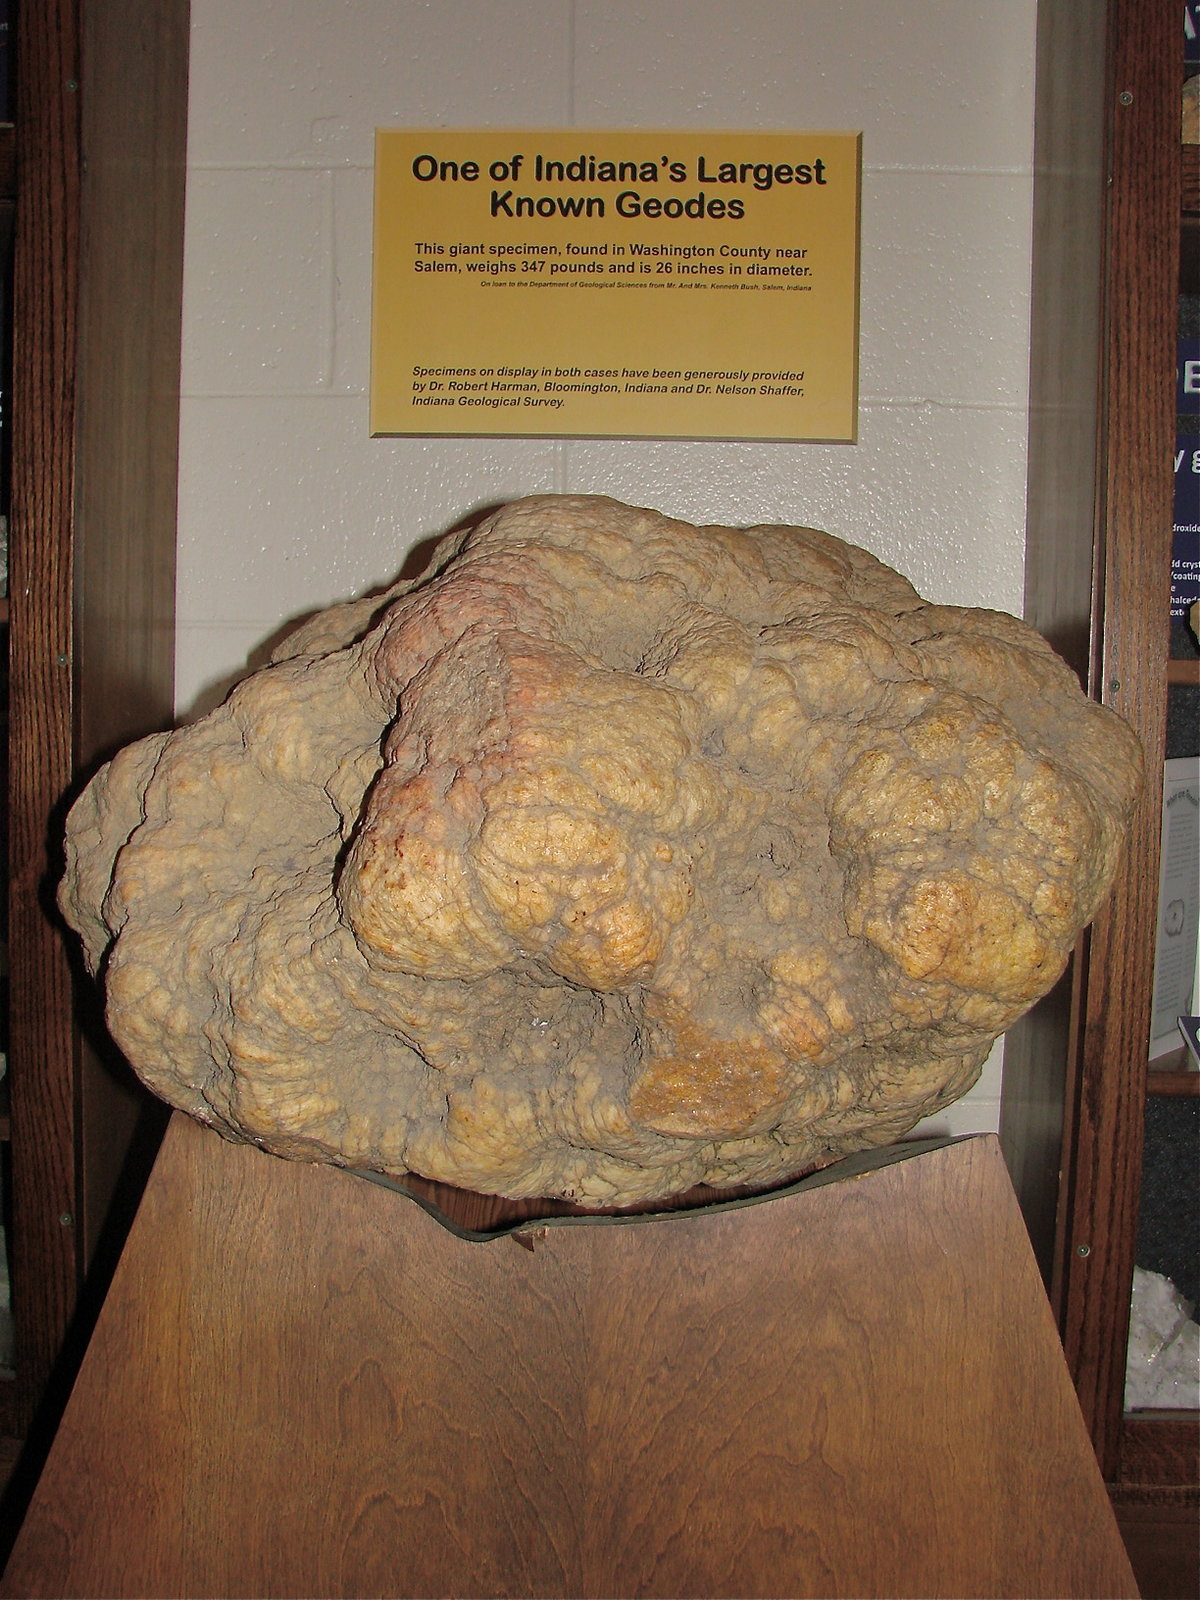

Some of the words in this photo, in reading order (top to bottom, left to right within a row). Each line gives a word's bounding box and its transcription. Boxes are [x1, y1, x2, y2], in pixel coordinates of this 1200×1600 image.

[412, 154, 480, 182] One
[489, 154, 525, 182] of
[535, 154, 687, 183] Indiana's
[698, 156, 827, 191] Largest
[490, 190, 605, 218] Known
[615, 191, 745, 220] Geodes
[415, 242, 445, 255] This
[449, 243, 485, 258] giant
[489, 243, 562, 259] specimen,
[565, 243, 608, 256] found
[612, 244, 626, 256] in
[629, 244, 715, 259] Washington
[719, 245, 771, 260] County
[776, 248, 807, 258] near
[414, 260, 461, 274] Salem,
[466, 260, 516, 275] weighs
[521, 261, 545, 273] 347
[550, 261, 604, 275] pounds
[608, 261, 635, 274] and
[639, 261, 652, 274] is
[656, 262, 673, 274] 26
[677, 262, 725, 275] inches
[729, 262, 742, 275] in
[746, 263, 813, 276] diameter.
[480, 280, 491, 288] On
[529, 281, 569, 290] Department
[579, 281, 615, 290] Geological
[710, 283, 739, 291] Kenneth
[762, 284, 785, 292] Salem,
[786, 284, 812, 292] Indiana
[412, 365, 477, 377] Specimens
[479, 368, 494, 377] on
[497, 366, 539, 379] display
[541, 366, 552, 377] in
[554, 367, 581, 378] both
[584, 369, 619, 378] cases
[621, 368, 650, 378] have
[652, 368, 681, 379] been
[684, 369, 749, 381] generously
[751, 371, 805, 382] provided
[412, 381, 426, 393] by
[429, 381, 445, 392] Dr.
[448, 381, 488, 392] Robert
[490, 382, 540, 393] Harman,
[544, 382, 621, 394] Bloomington,
[624, 383, 668, 393] Indiana
[671, 384, 694, 394] and
[696, 384, 712, 394] Dr.
[715, 384, 756, 395] Nelson
[759, 385, 805, 397] Shaffer,
[412, 396, 455, 406] Indiana
[458, 396, 520, 409] Geological
[523, 397, 565, 409] Survey.
